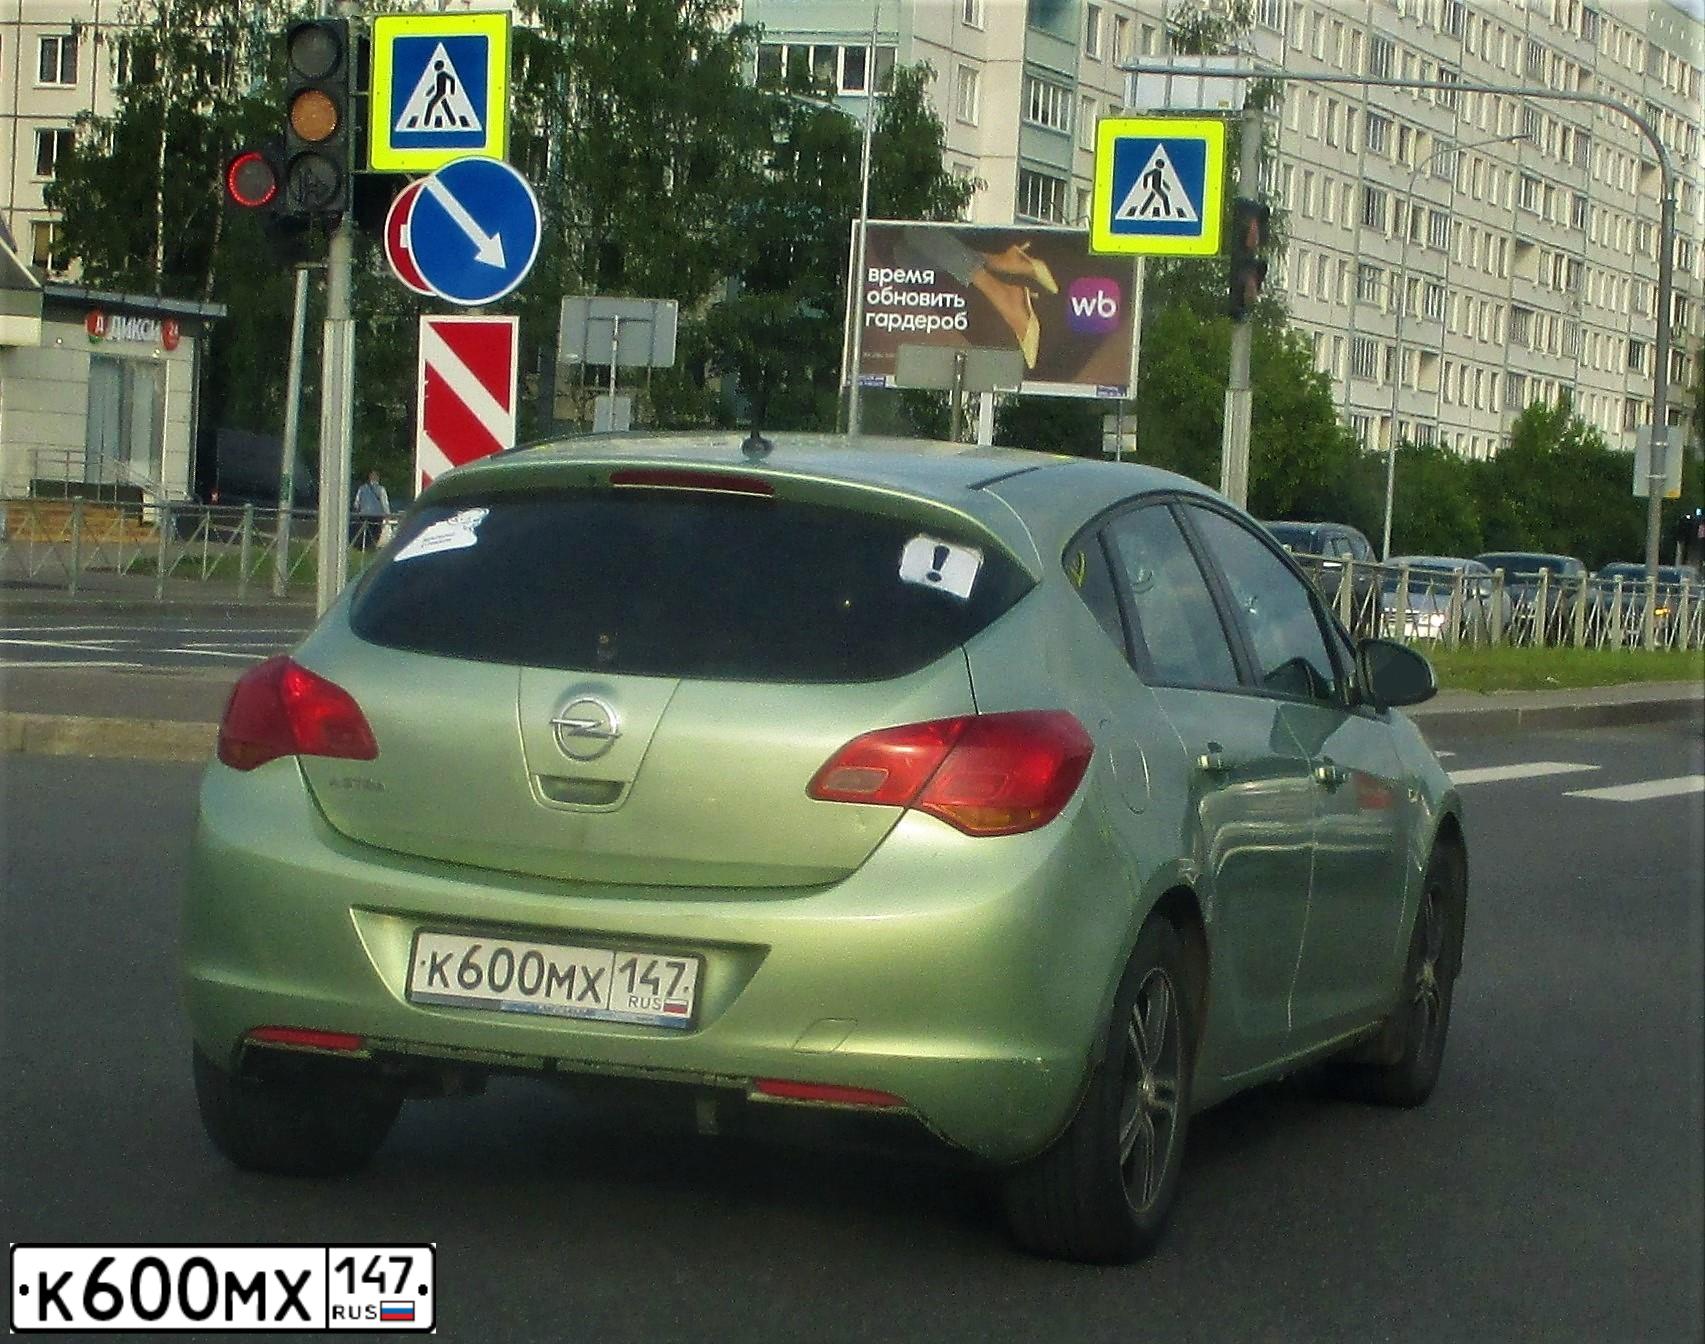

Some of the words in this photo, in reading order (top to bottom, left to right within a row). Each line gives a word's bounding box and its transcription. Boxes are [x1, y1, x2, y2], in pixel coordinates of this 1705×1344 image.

[867, 267, 935, 289] время
[866, 286, 966, 308] обновить
[1072, 290, 1117, 318] wb
[110, 315, 162, 341] ДИКСИ
[865, 310, 968, 333] гардероб
[427, 944, 606, 1004] К600МХ
[619, 957, 686, 998] 147
[628, 995, 661, 1011] RUS
